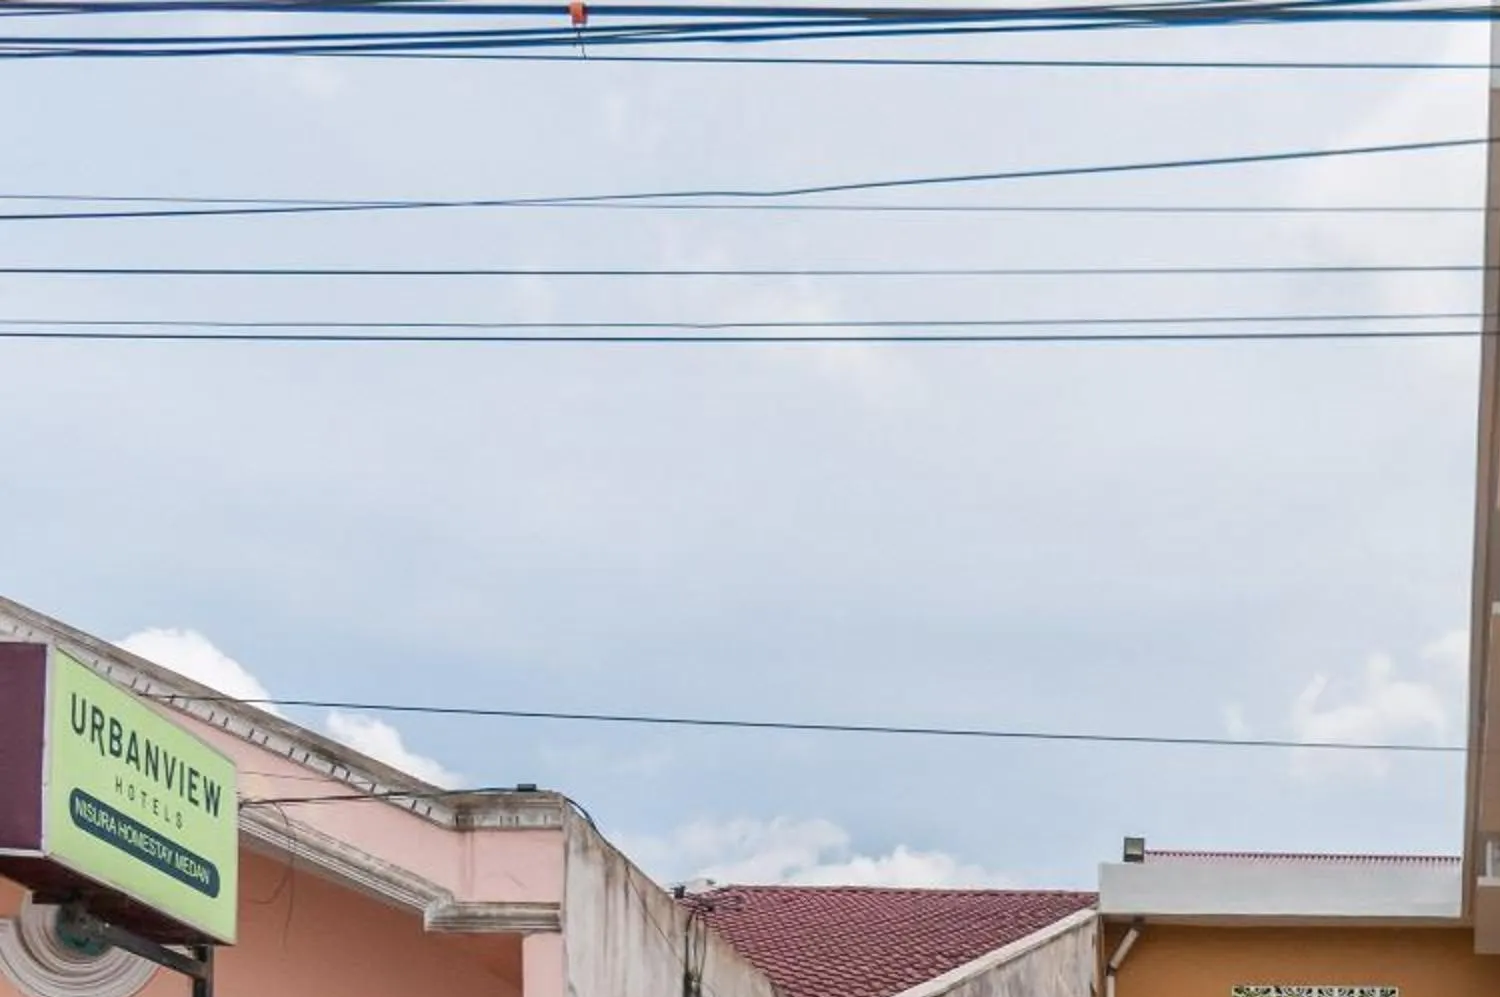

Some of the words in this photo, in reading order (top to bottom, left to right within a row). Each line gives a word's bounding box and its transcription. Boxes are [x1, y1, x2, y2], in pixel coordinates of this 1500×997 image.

[70, 692, 222, 818] URBANVIEW
[75, 796, 117, 836] NISURA
[117, 822, 174, 865] HOMESTAY
[174, 851, 211, 885] MEDAN
[115, 776, 184, 830] HOTELS
